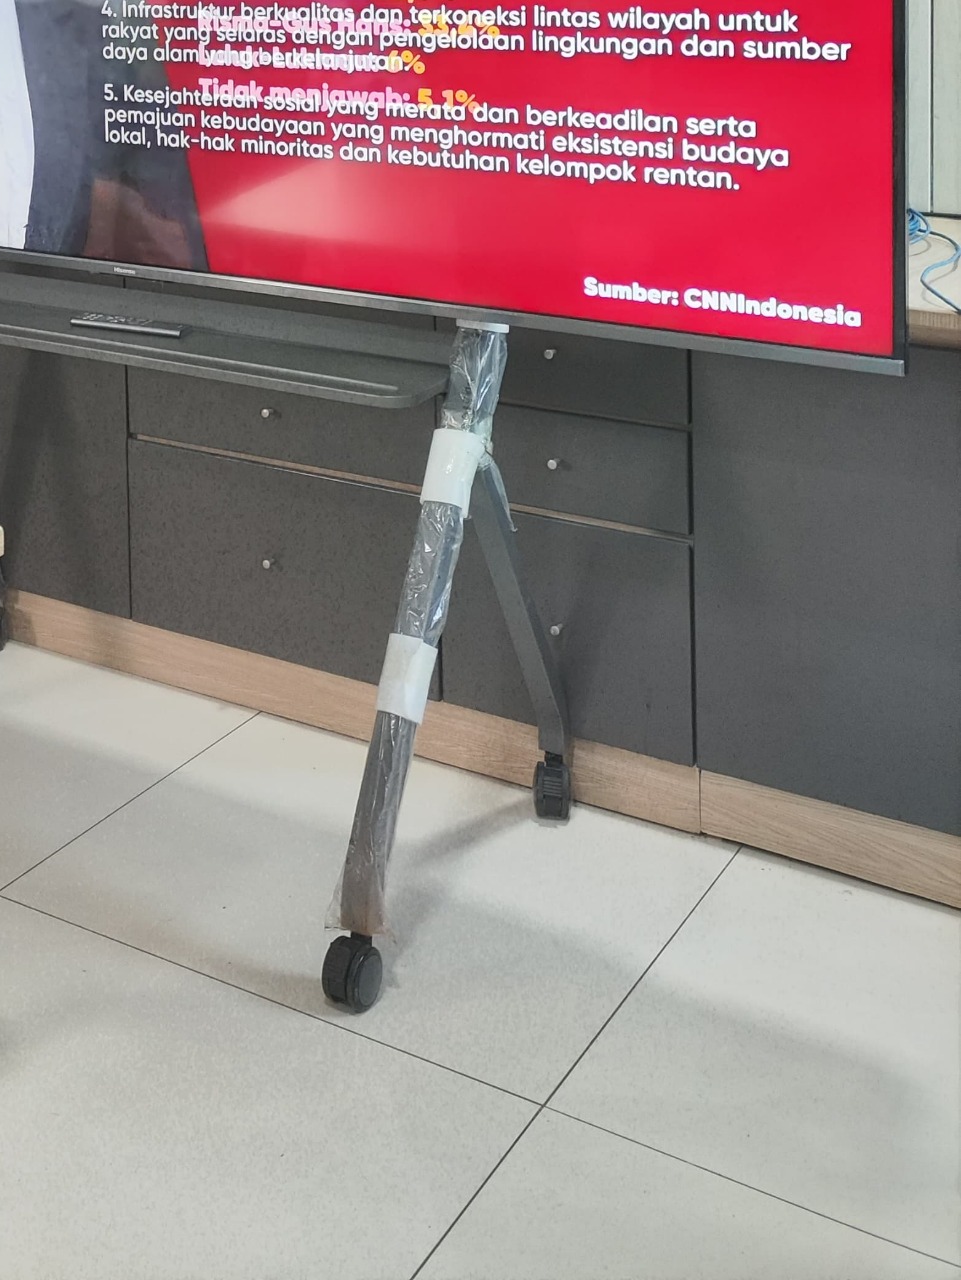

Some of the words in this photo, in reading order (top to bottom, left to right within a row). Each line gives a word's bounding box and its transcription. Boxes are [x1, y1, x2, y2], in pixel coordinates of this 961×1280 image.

[240, 1, 354, 23] berkualitas
[360, 3, 402, 24] dan
[409, 4, 526, 27] terkoneksi
[533, 5, 601, 29] lintas
[608, 6, 709, 35] wilayah
[718, 9, 798, 32] untuk
[102, 21, 158, 43] rakyat
[164, 25, 210, 45] yang
[291, 25, 373, 50] dengan
[378, 27, 524, 54] pengelolaan
[531, 29, 672, 60] lingkungan
[680, 34, 734, 58] dan
[743, 37, 850, 61] sumber
[102, 41, 147, 64] daya
[153, 42, 198, 63] alam
[326, 97, 378, 121] yang
[385, 98, 465, 122] merata
[472, 101, 519, 124] dan
[526, 104, 678, 134] berkeadilan
[686, 116, 756, 138] serta
[104, 107, 195, 132] pemajuan
[200, 110, 324, 140] kebudayaan
[330, 122, 384, 145] yang
[390, 124, 545, 155] menghormati
[551, 131, 674, 160] eksistensi
[682, 138, 789, 171] budaya
[104, 124, 151, 149] lokal,
[156, 128, 235, 152] hak-hak
[241, 134, 333, 159] minoritas
[339, 141, 380, 163] dan
[387, 144, 509, 173] kebutuhan
[516, 152, 636, 185] kelompok
[644, 166, 740, 190] rentan.
[583, 276, 679, 306] Sumber:
[683, 287, 861, 328] CNNIndonesia
